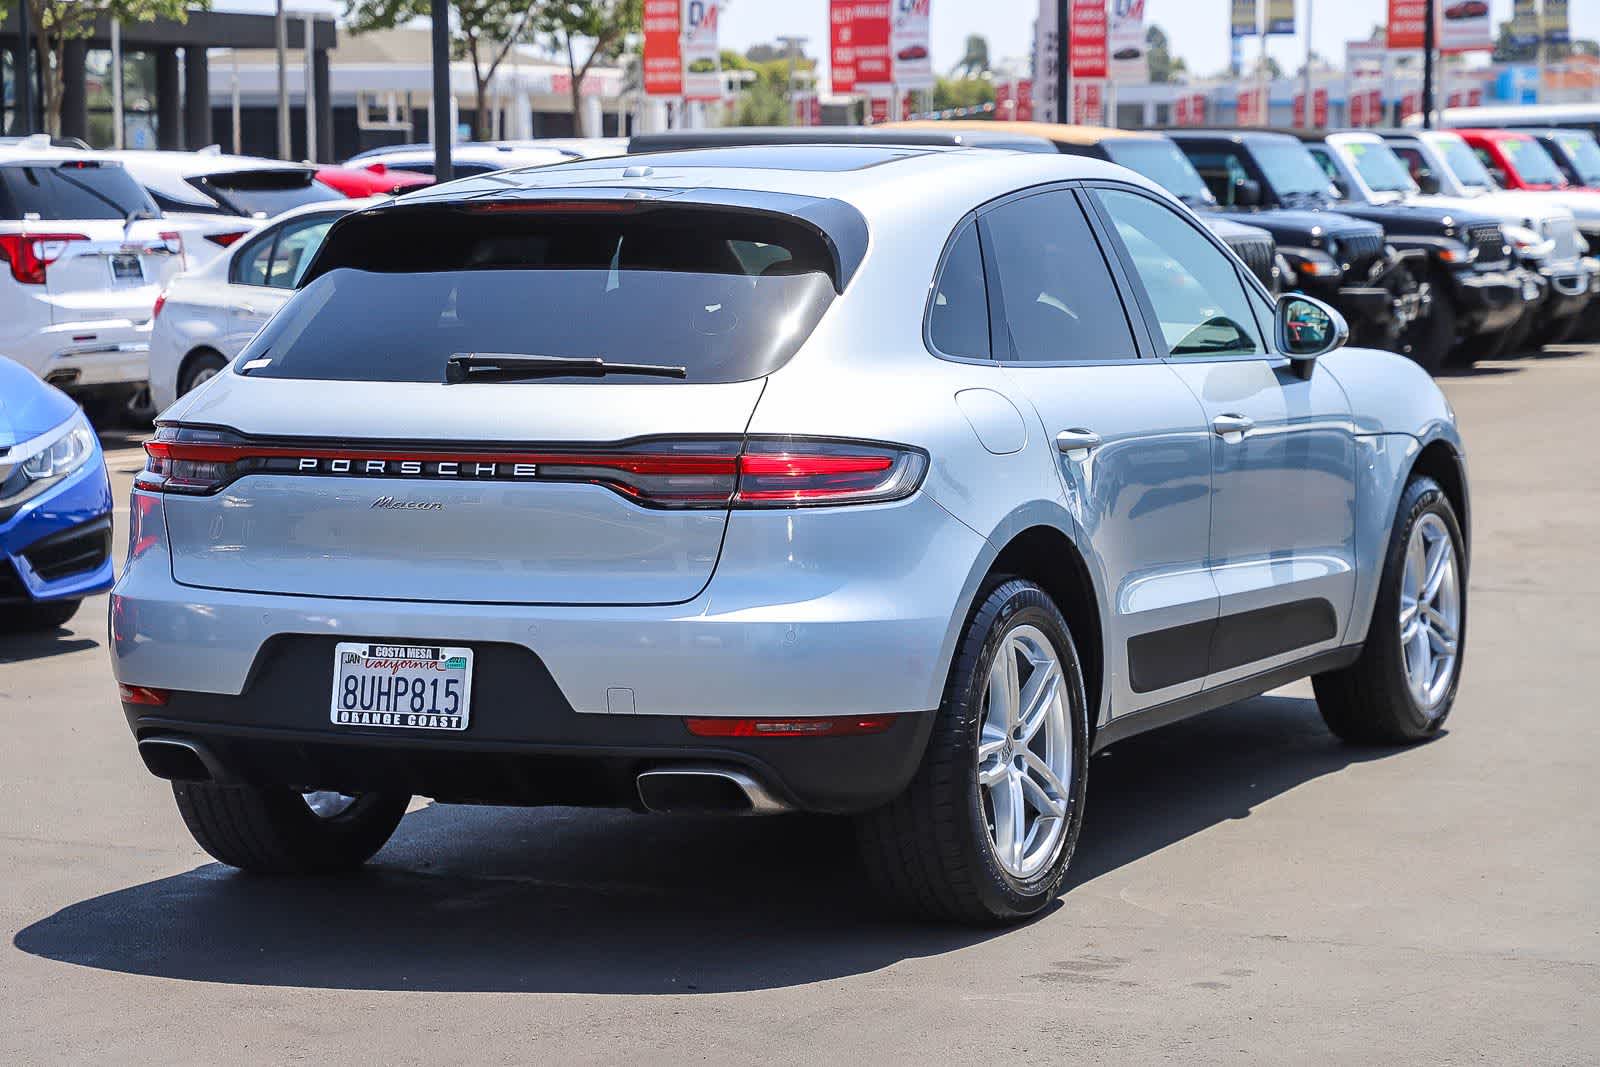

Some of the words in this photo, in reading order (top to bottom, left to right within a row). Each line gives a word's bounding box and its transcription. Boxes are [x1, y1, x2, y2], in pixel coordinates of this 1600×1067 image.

[298, 458, 537, 476] PORSCHE
[368, 495, 444, 511] Macan
[344, 653, 361, 665] JAN
[375, 646, 405, 658] COSTA
[406, 647, 433, 659] MESA
[365, 659, 446, 675] California
[342, 674, 459, 715] 8UHP815
[340, 711, 401, 725] ORANGE
[407, 714, 459, 728] COAST
